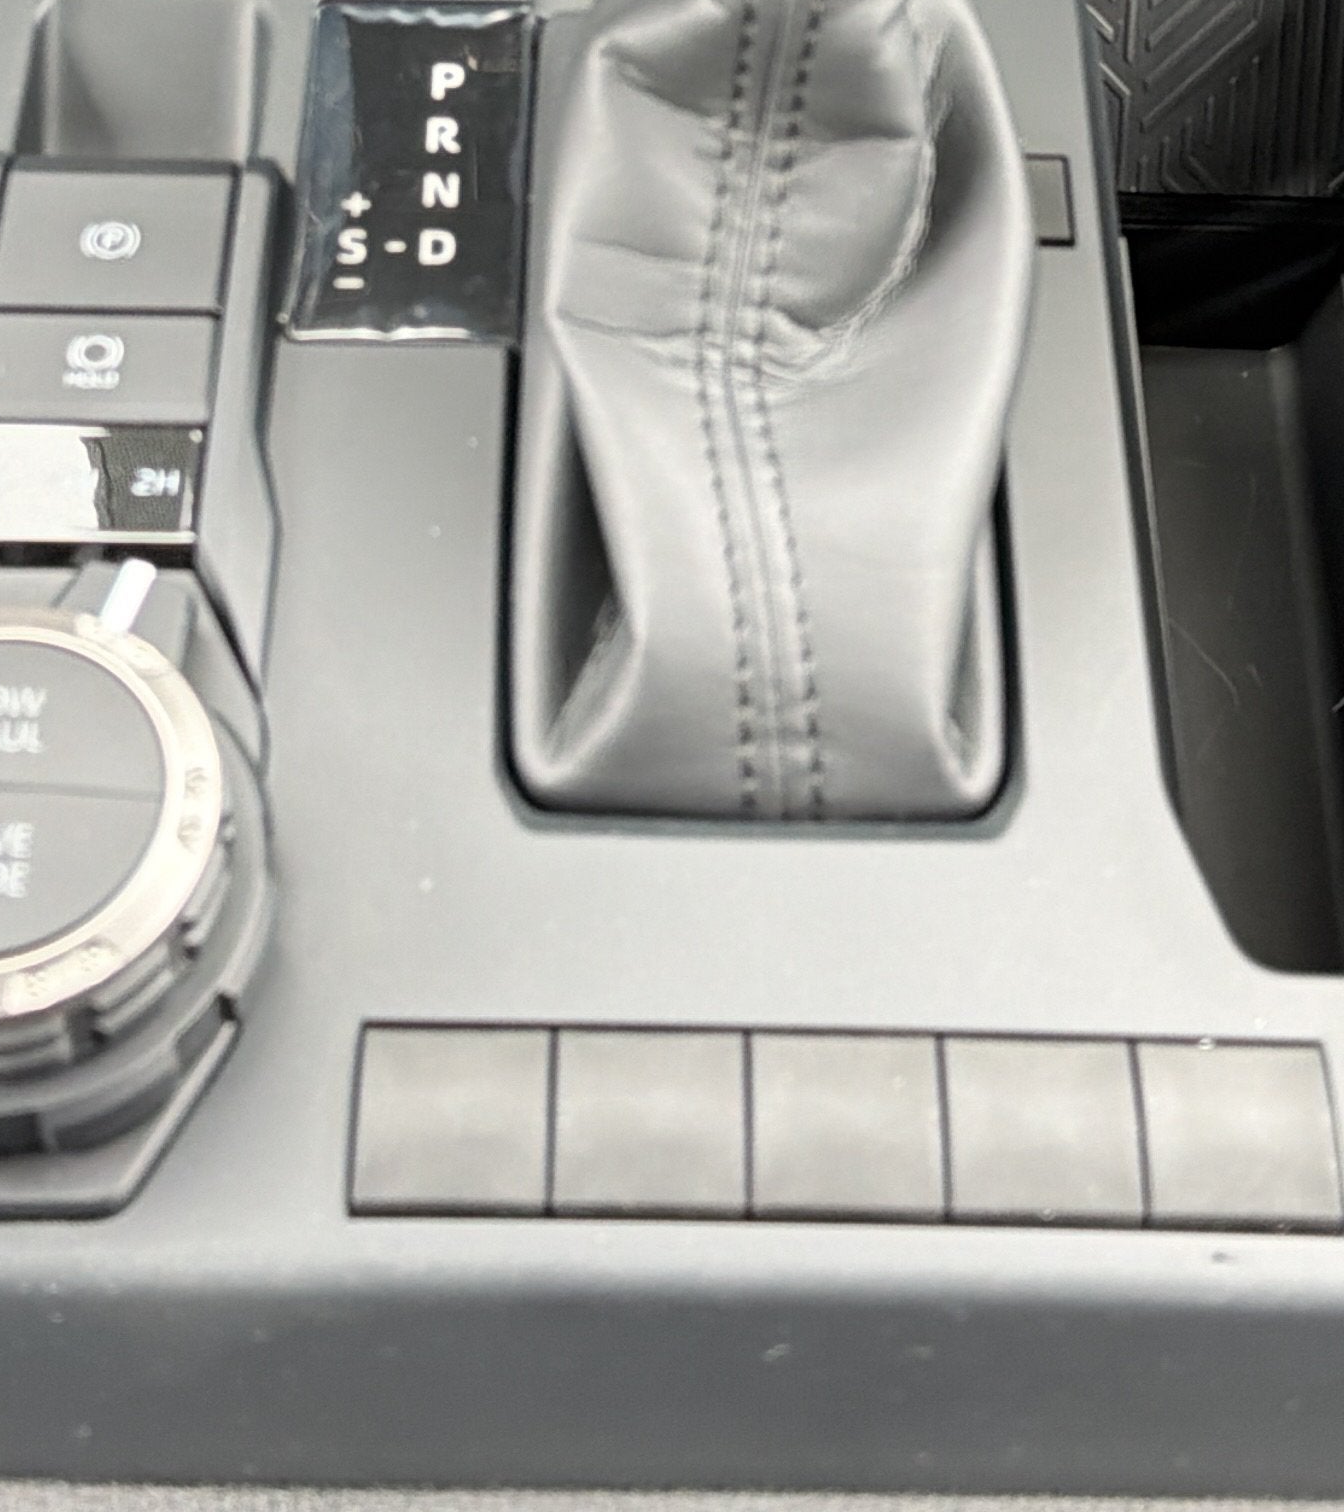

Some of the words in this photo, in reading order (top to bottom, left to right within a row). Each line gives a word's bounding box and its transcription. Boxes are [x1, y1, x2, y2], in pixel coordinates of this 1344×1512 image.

[431, 62, 465, 100] P
[425, 116, 461, 153] R
[422, 171, 460, 208] N
[336, 228, 367, 265] S
[418, 229, 456, 266] D
